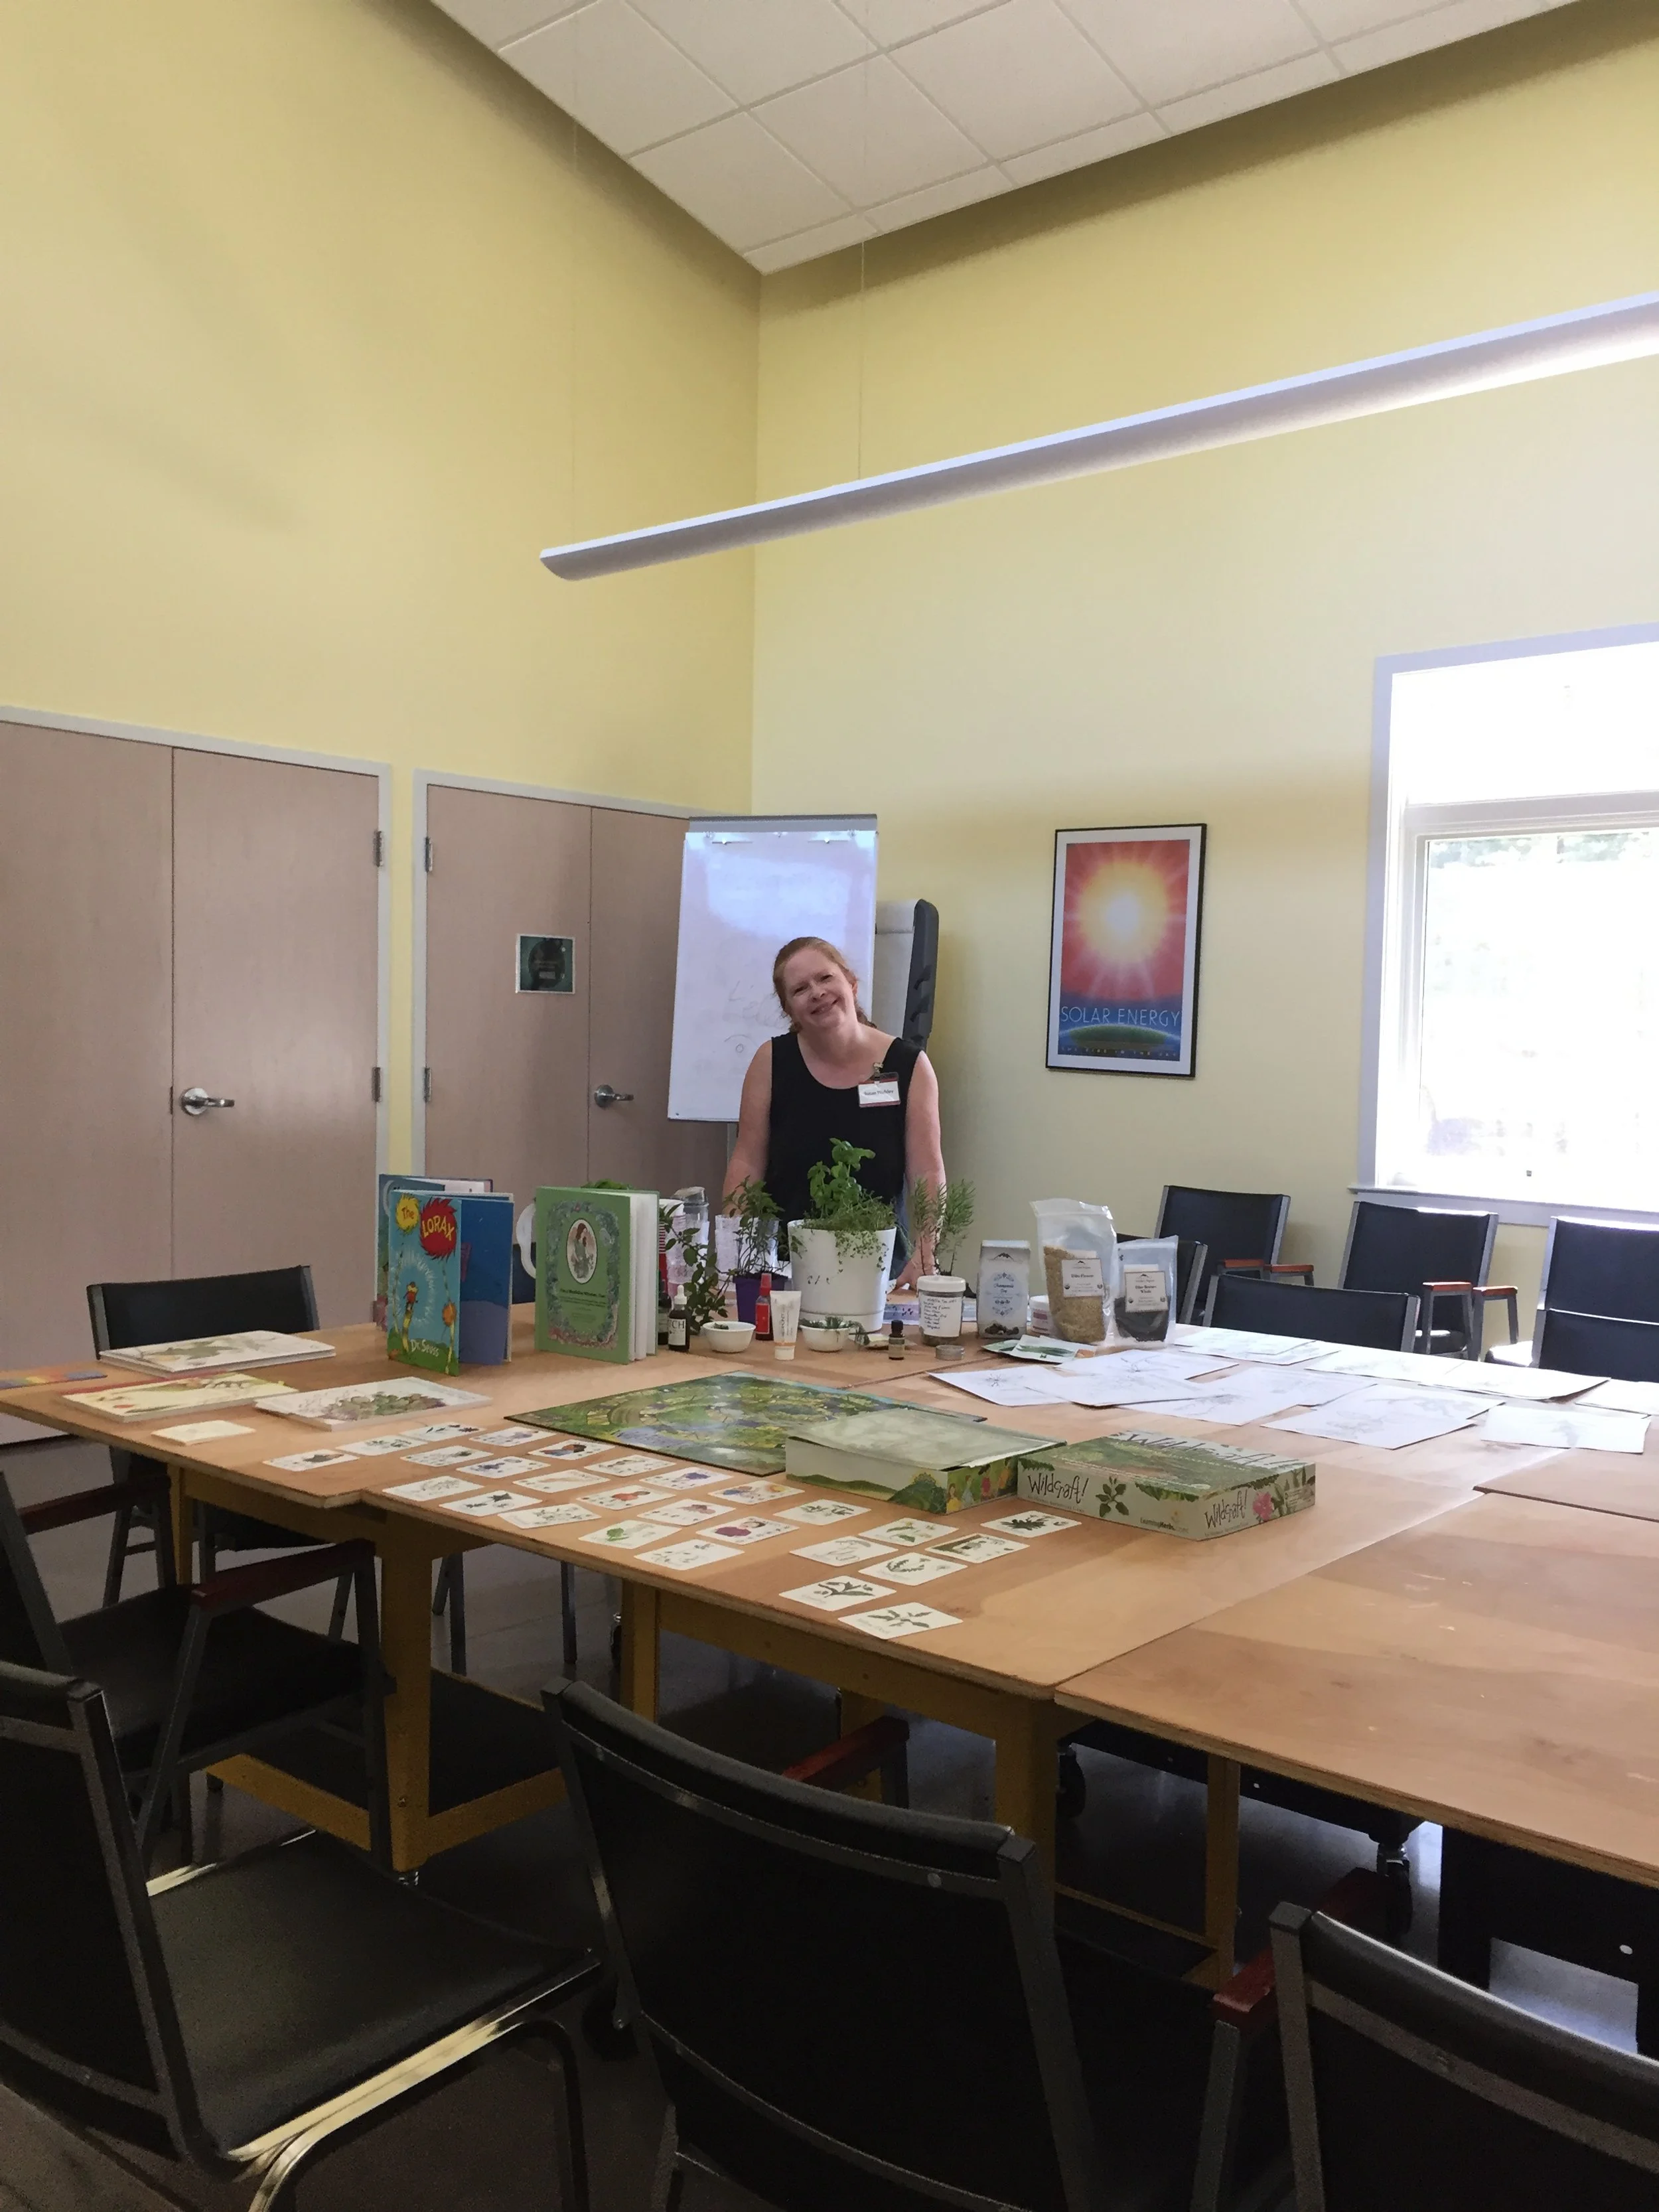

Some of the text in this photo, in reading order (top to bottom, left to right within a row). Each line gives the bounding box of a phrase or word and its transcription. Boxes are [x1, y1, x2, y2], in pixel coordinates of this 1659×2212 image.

[1061, 1006, 1180, 1027] SOLAR ENERGY
[401, 1206, 455, 1242] The LORAX
[421, 1339, 439, 1357] Seuss
[1027, 1473, 1089, 1504] Wildcraft!
[1204, 1489, 1248, 1529] Wildcraft!
